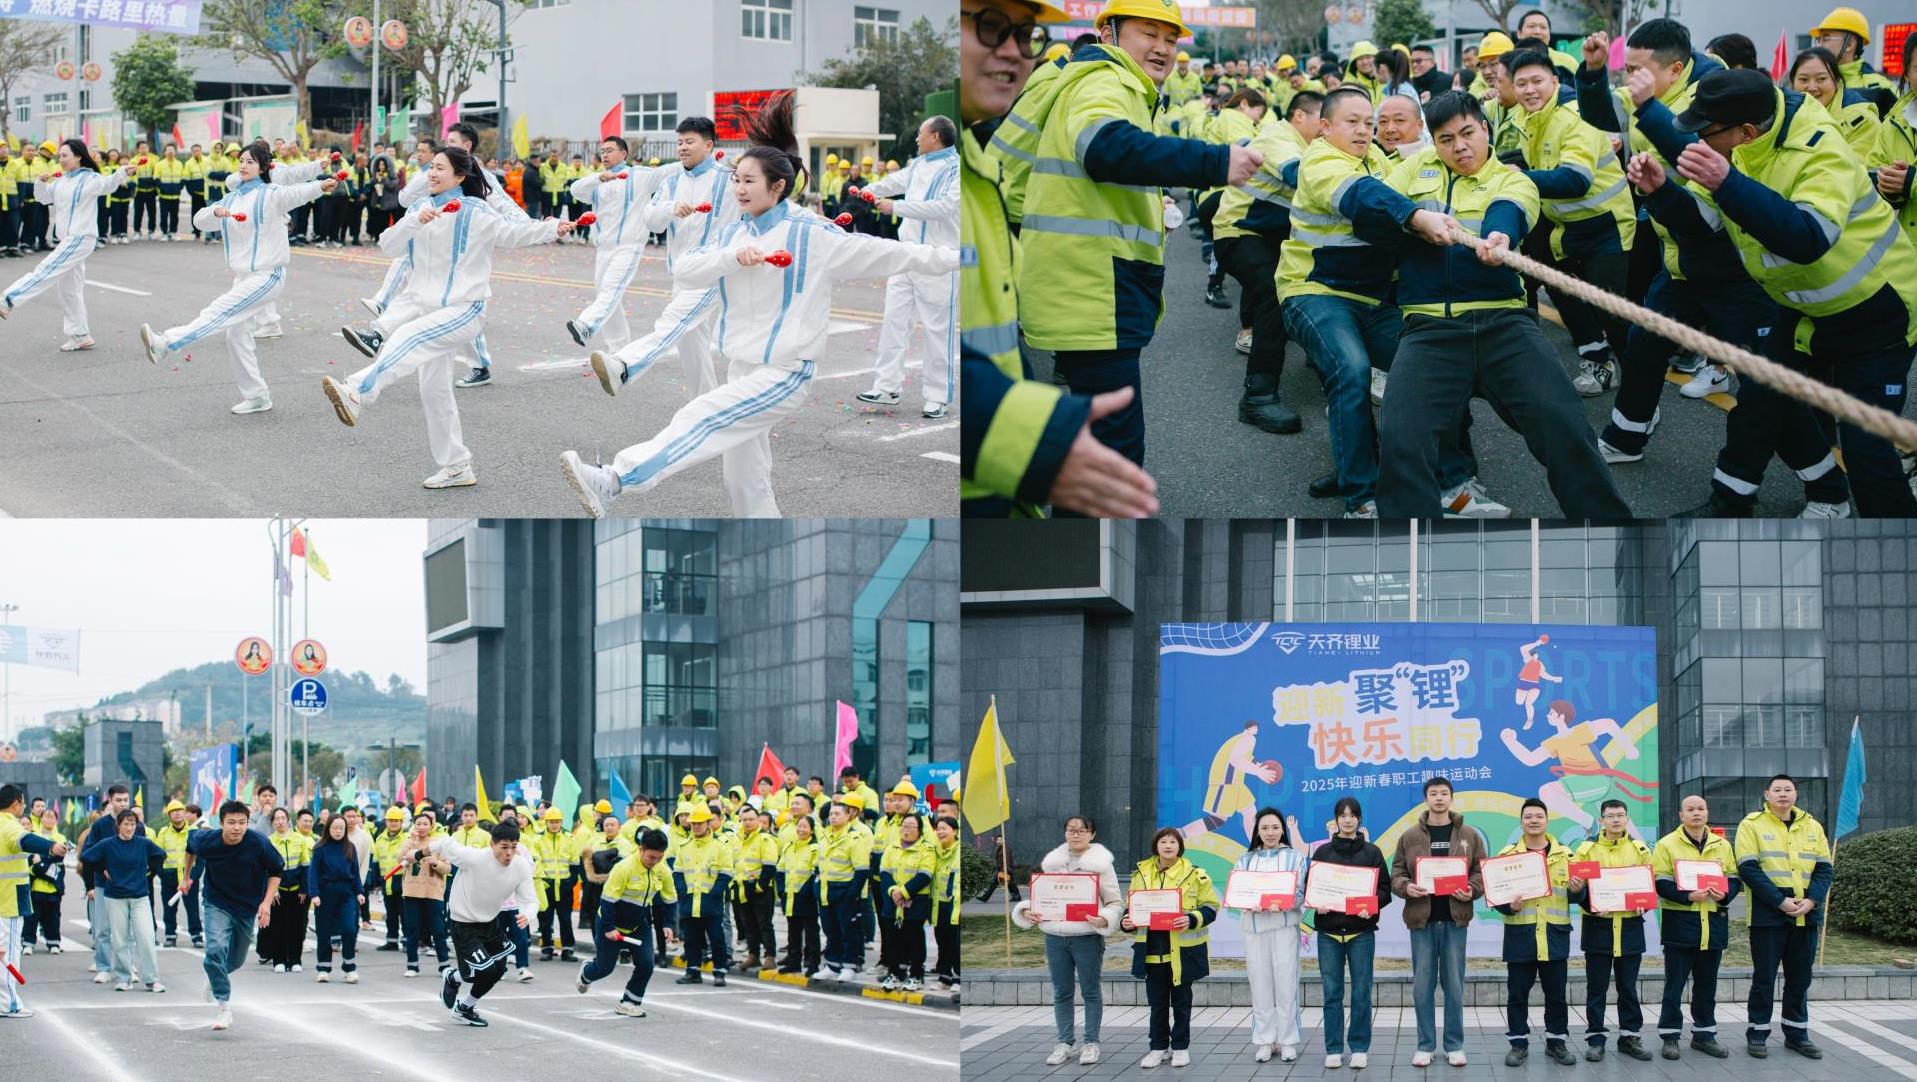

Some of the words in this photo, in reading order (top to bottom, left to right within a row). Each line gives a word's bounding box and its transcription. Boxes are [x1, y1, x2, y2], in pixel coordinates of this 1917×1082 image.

[29, 0, 188, 27] 燃烧卡路里热量
[1307, 634, 1380, 650] 天齐锂业
[303, 682, 317, 700] P
[1313, 718, 1479, 765] 快乐同行
[1301, 766, 1493, 792] 2025年迎新春职工趣味运动会
[471, 948, 486, 963] 11
